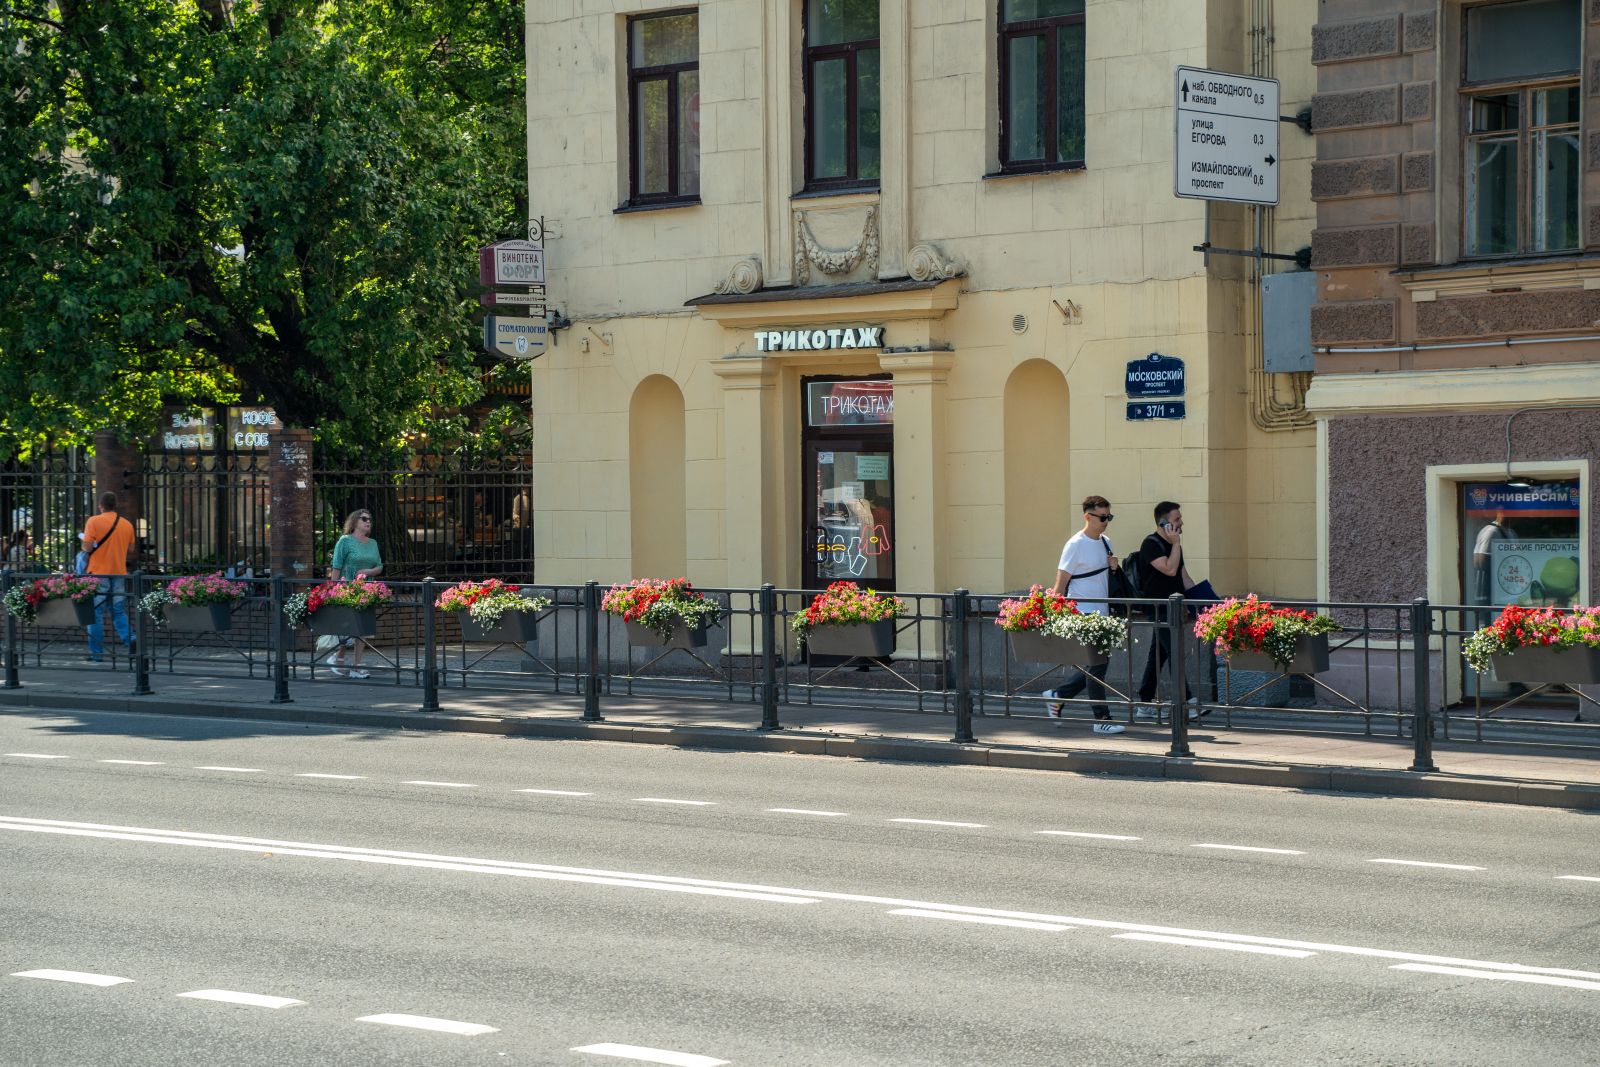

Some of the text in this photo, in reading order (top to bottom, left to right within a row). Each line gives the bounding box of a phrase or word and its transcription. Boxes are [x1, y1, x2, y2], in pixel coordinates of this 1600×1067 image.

[1192, 81, 1252, 97] наб. ОБВОДНОГО
[1192, 95, 1217, 105] канала
[1254, 93, 1264, 105] 0,5
[1192, 119, 1214, 130] улица
[1192, 132, 1264, 147] ЕГОРОВА 0,3
[1192, 161, 1253, 178] ИЗМАЙЛОВСКИЙ
[1192, 178, 1224, 190] проспект
[1253, 174, 1264, 187] 0,6
[502, 252, 539, 264] ВИНОТЕКА
[498, 324, 546, 334] СТОМАТОЛОГИЯ
[754, 327, 881, 352] ТРИКОТАЖ
[1128, 368, 1183, 382] МОСКОВСКИЙ
[1146, 404, 1165, 417] 37/1
[242, 410, 276, 426] КОФЕ
[1488, 492, 1568, 502] УНИВЕРСАМ
[1498, 543, 1580, 553] СВЕЖИЕ ПРОДУКТЫ
[1508, 565, 1519, 575] 24
